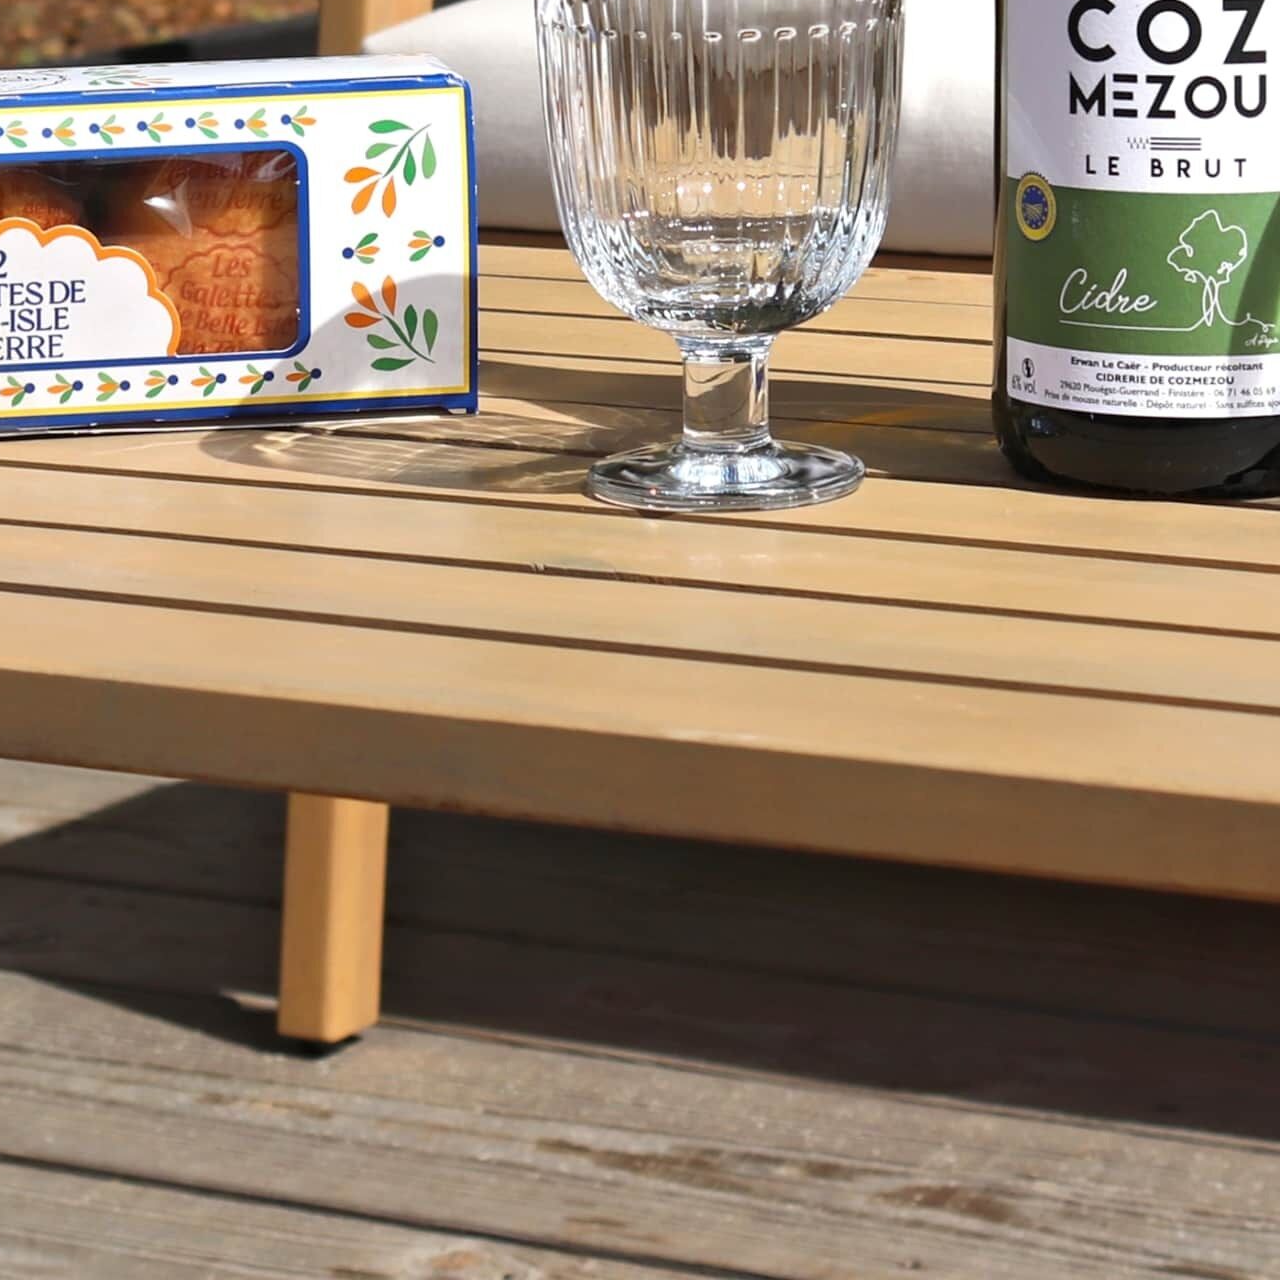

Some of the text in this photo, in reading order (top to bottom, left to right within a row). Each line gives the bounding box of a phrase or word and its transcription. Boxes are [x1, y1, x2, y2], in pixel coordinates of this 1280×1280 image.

[1069, 71, 1267, 119] MEZOU
[1086, 154, 1247, 178] LE BRUT
[211, 251, 253, 278] Les
[49, 280, 86, 305] DE
[1060, 268, 1158, 313] Cidre
[195, 307, 249, 336] Belle
[1070, 356, 1099, 368] Erwan
[1102, 359, 1114, 369] Le
[1116, 361, 1141, 370] Caër
[1152, 362, 1212, 372] Producteur
[1215, 362, 1263, 372] récoltant
[1095, 372, 1235, 385] CIDRERIE DE COZMEZOU
[1227, 388, 1237, 397] 71
